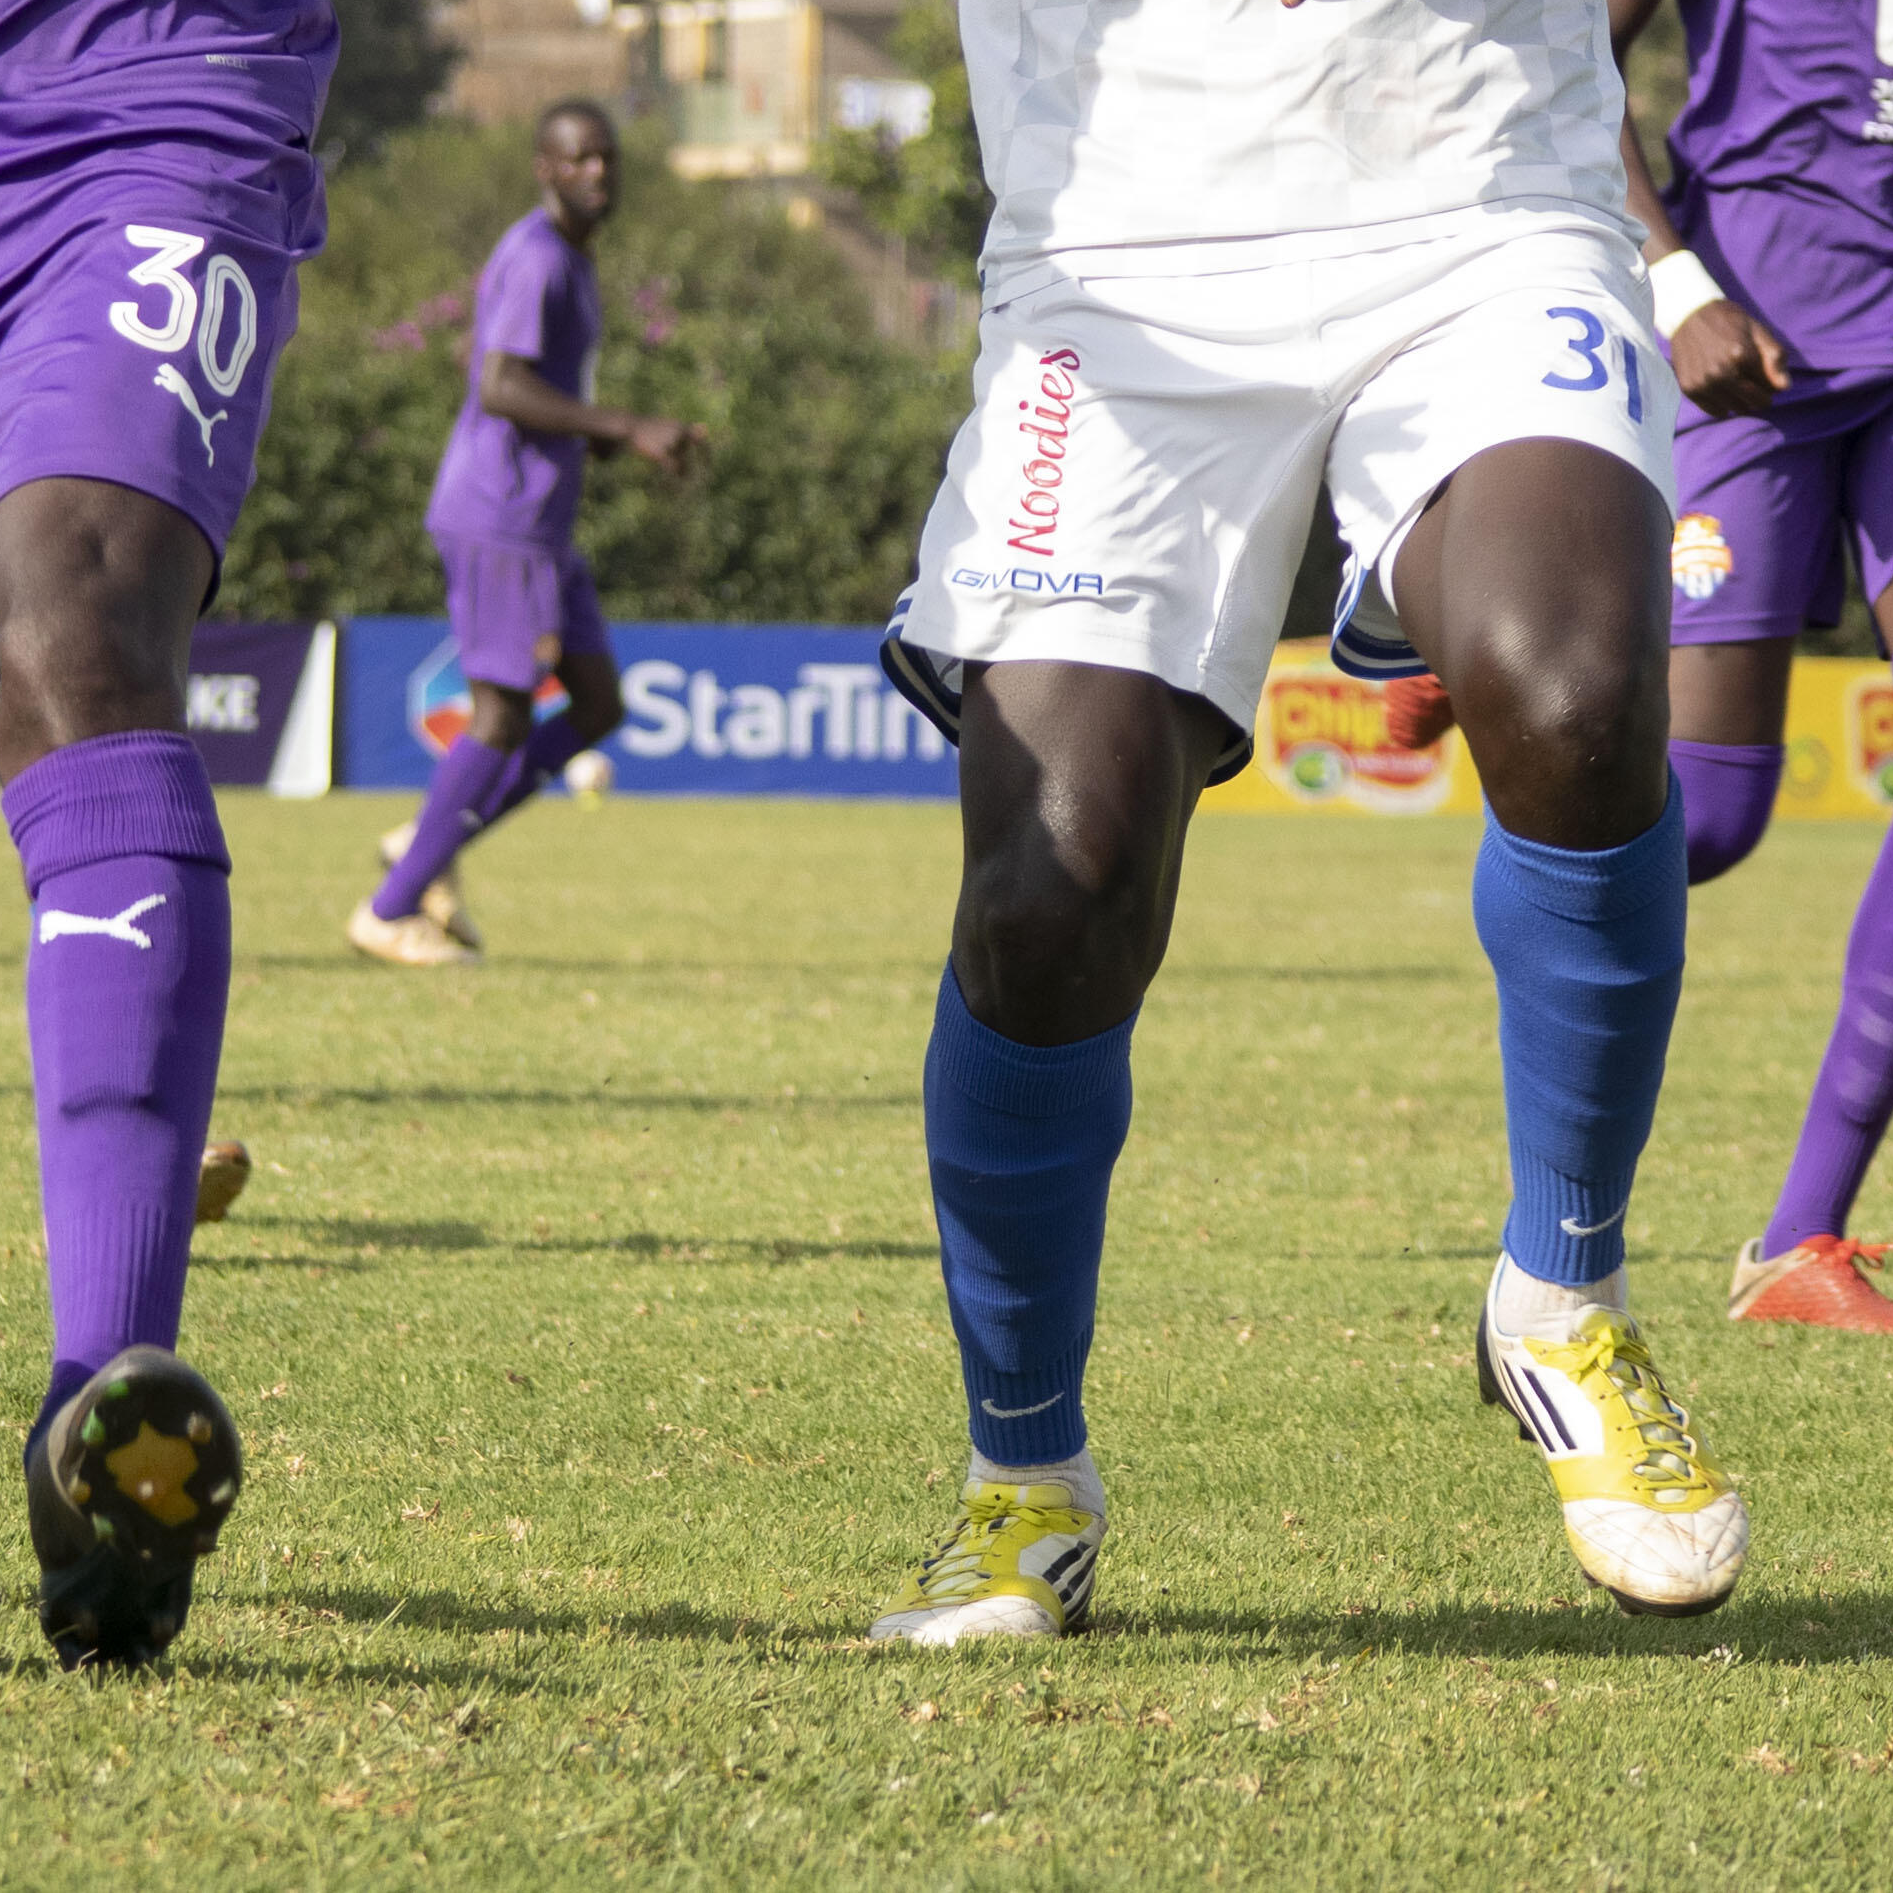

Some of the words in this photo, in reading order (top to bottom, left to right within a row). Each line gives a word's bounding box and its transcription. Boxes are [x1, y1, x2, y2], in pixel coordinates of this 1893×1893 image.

[109, 224, 257, 397] 30
[1542, 306, 1644, 424] 31
[1007, 346, 1082, 557] Noodies
[951, 567, 1104, 597] GIVOVA
